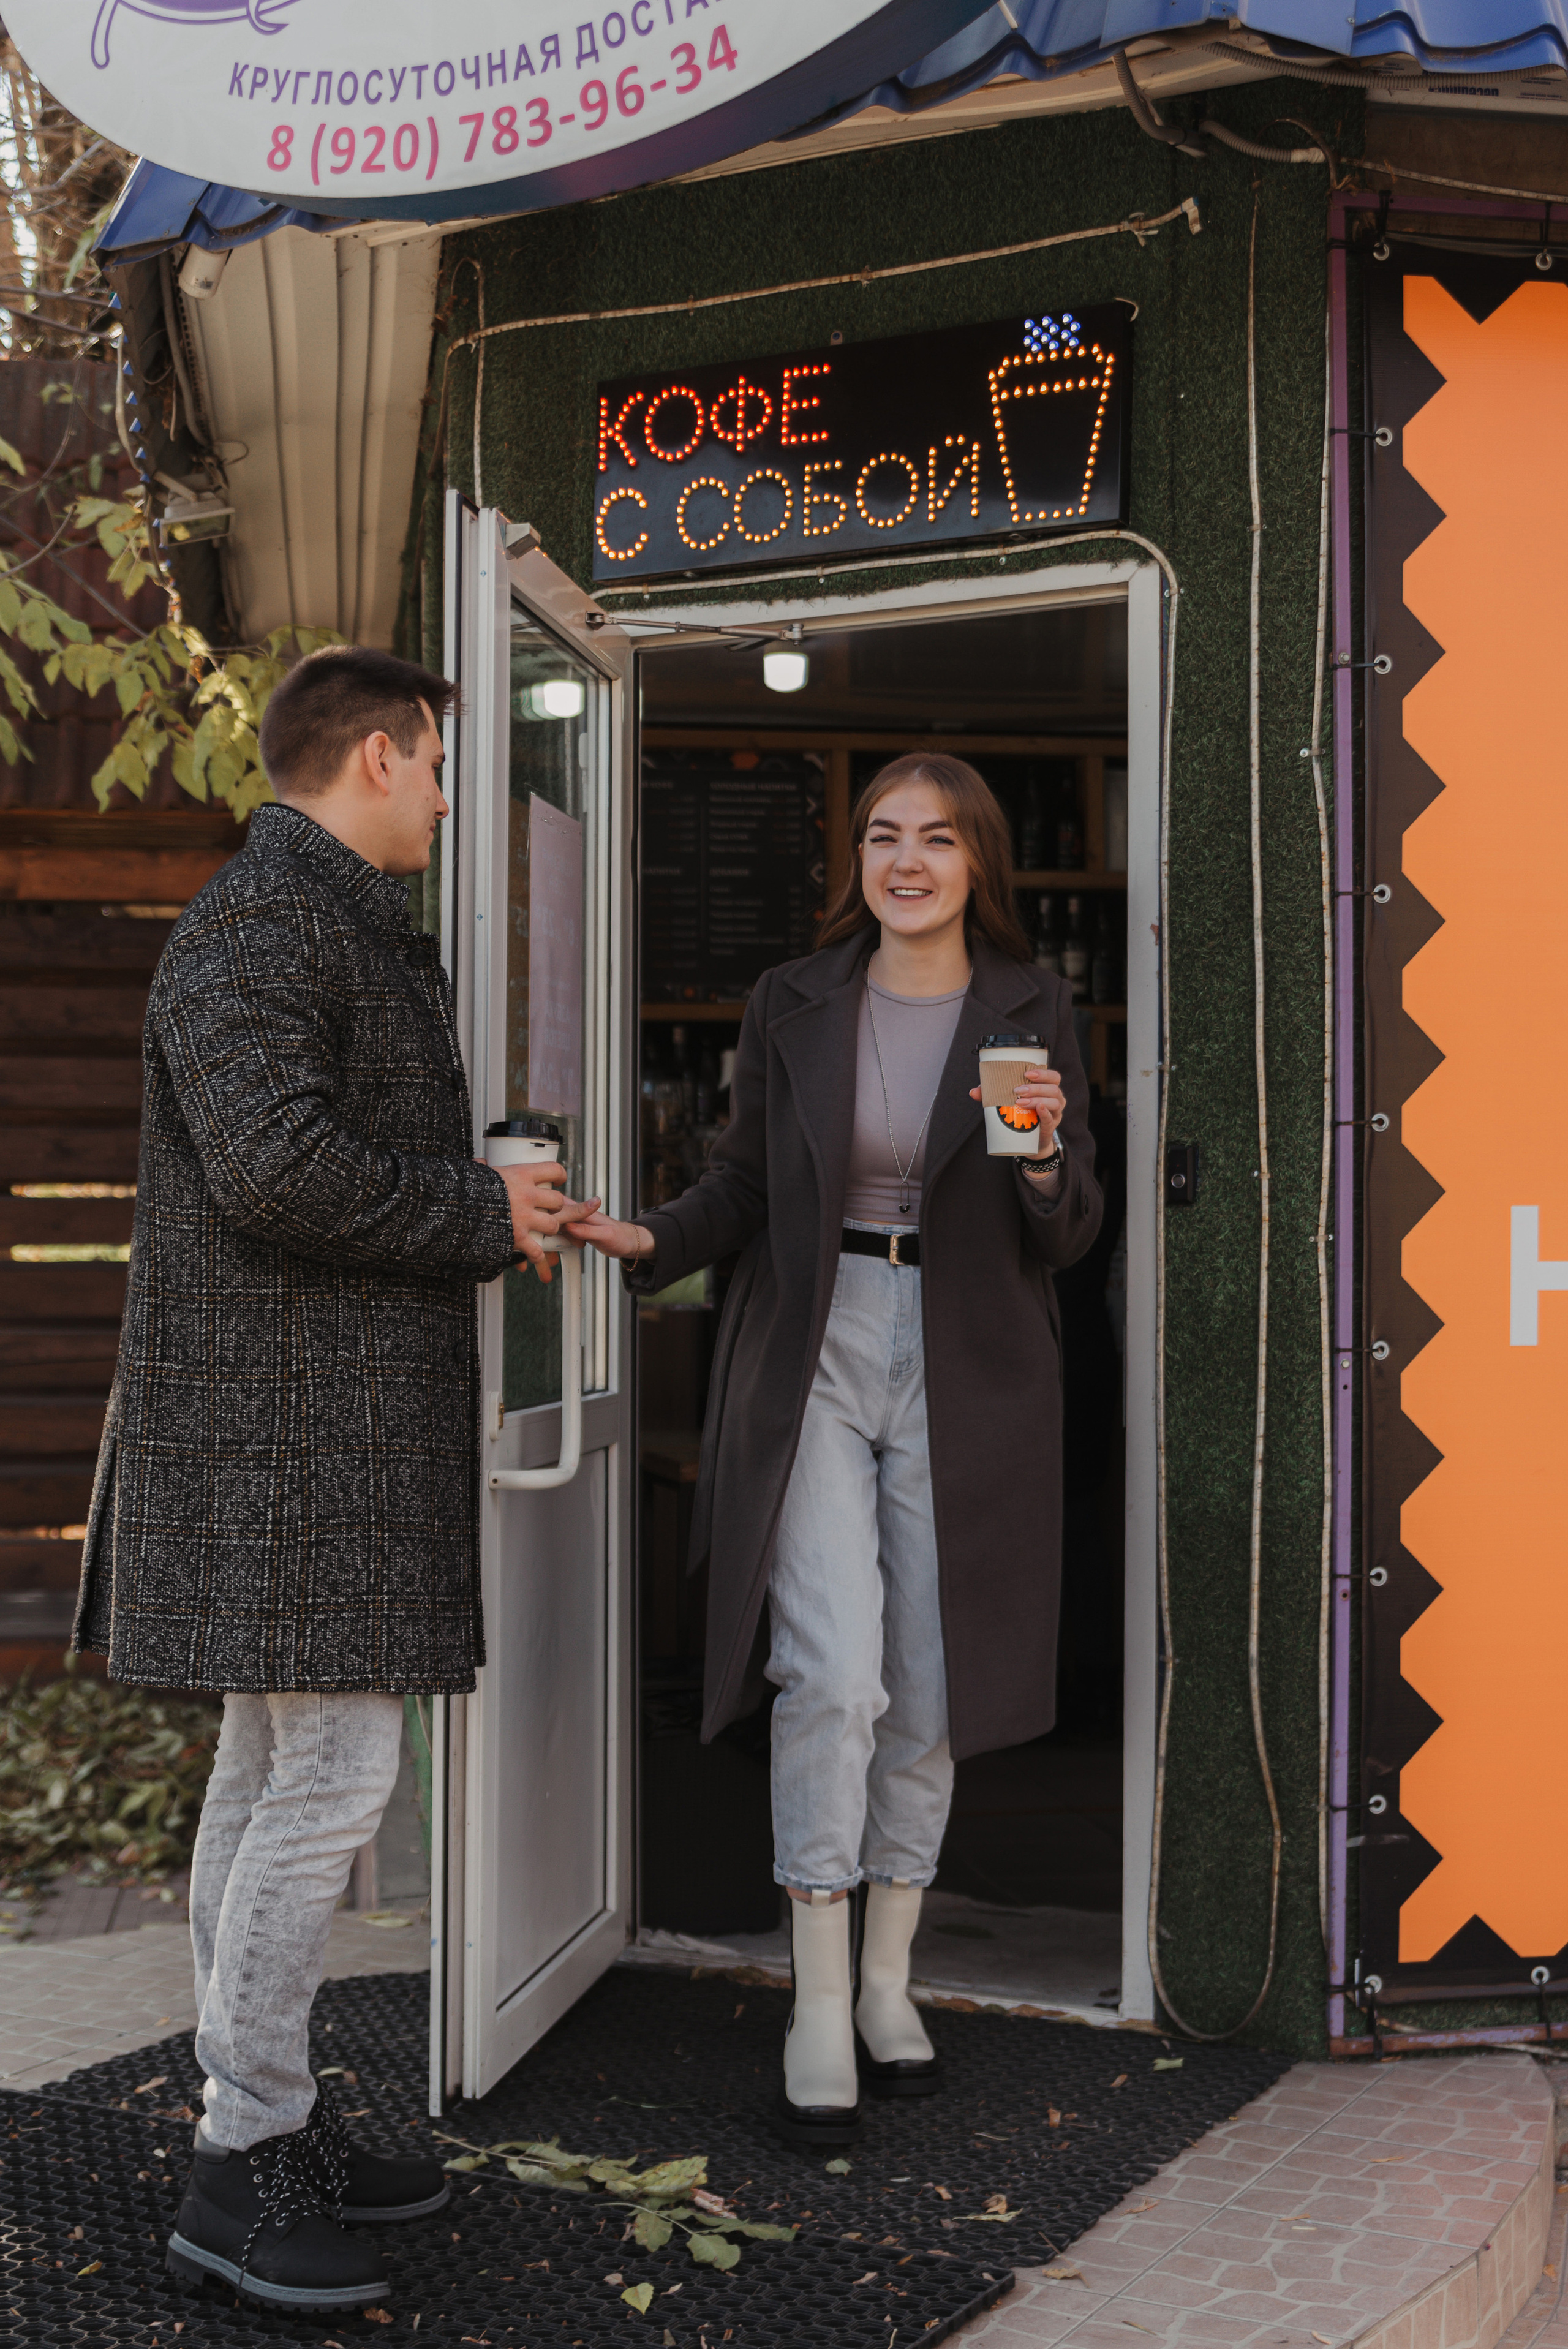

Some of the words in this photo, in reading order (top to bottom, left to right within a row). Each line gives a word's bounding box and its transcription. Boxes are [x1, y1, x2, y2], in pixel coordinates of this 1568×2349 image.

[228, 34, 562, 105] КРУГЛОСУТОЧНАЯ
[267, 124, 295, 172] 8
[311, 116, 440, 186] (920)
[459, 24, 739, 162] 783-96-34
[598, 363, 832, 472] КОФЕ
[595, 487, 649, 561] С
[676, 434, 981, 551] СОБОЙ
